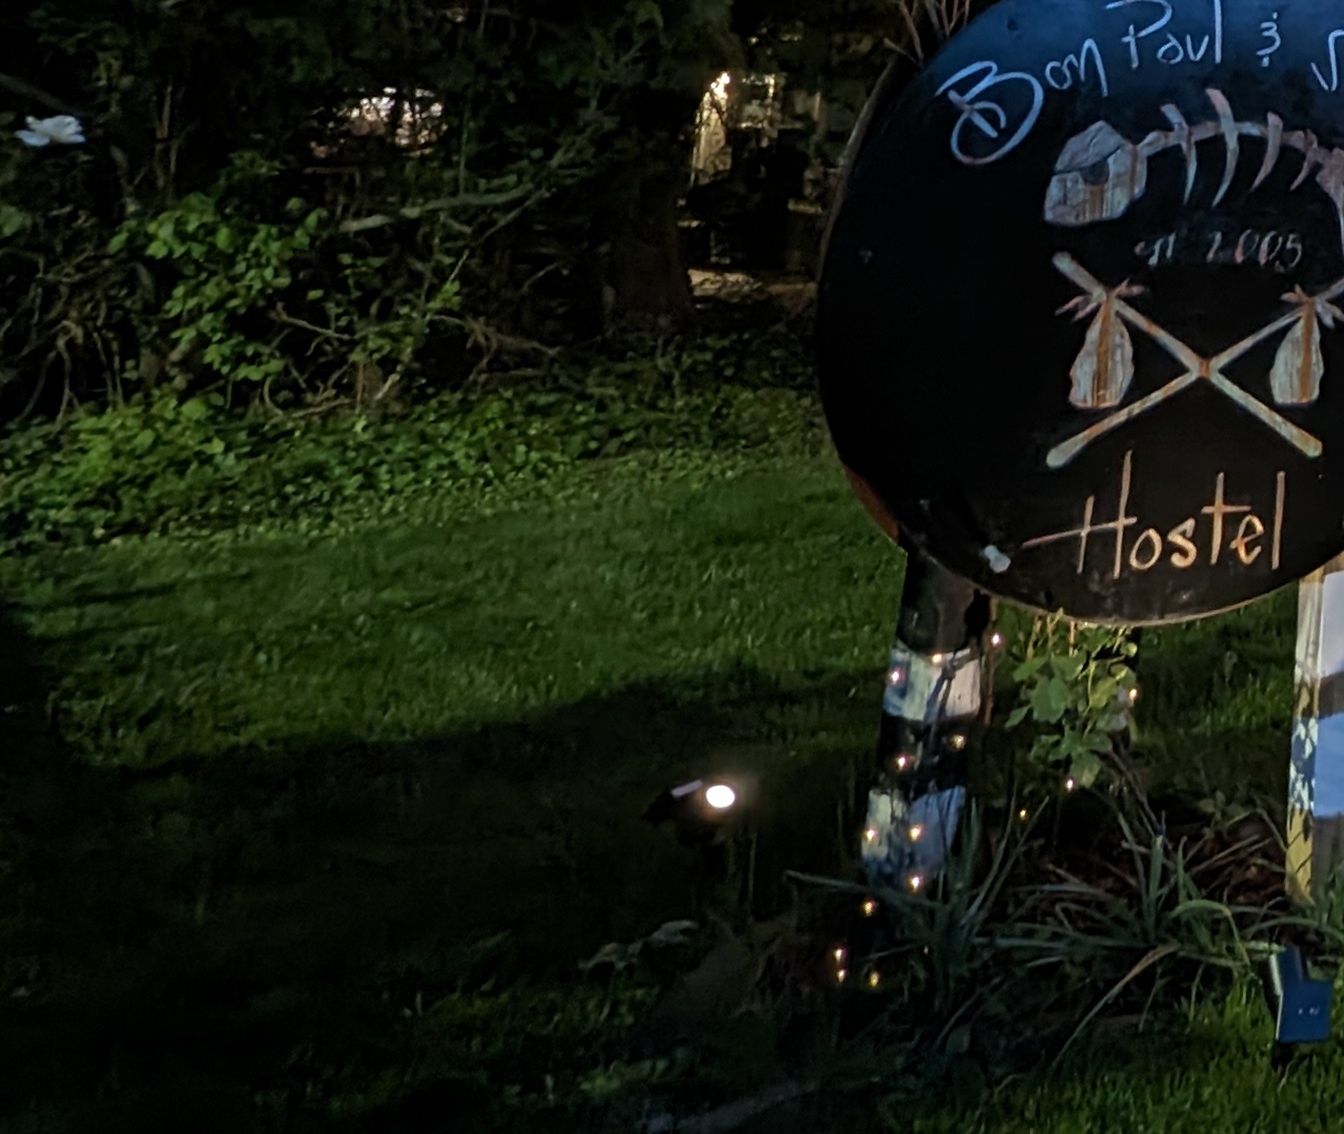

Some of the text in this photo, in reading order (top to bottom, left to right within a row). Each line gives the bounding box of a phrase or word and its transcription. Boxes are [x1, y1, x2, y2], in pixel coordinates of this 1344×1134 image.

[935, 38, 1109, 165] Bon
[1206, 229, 1303, 274] 2005
[1021, 449, 1287, 580] Hostel
